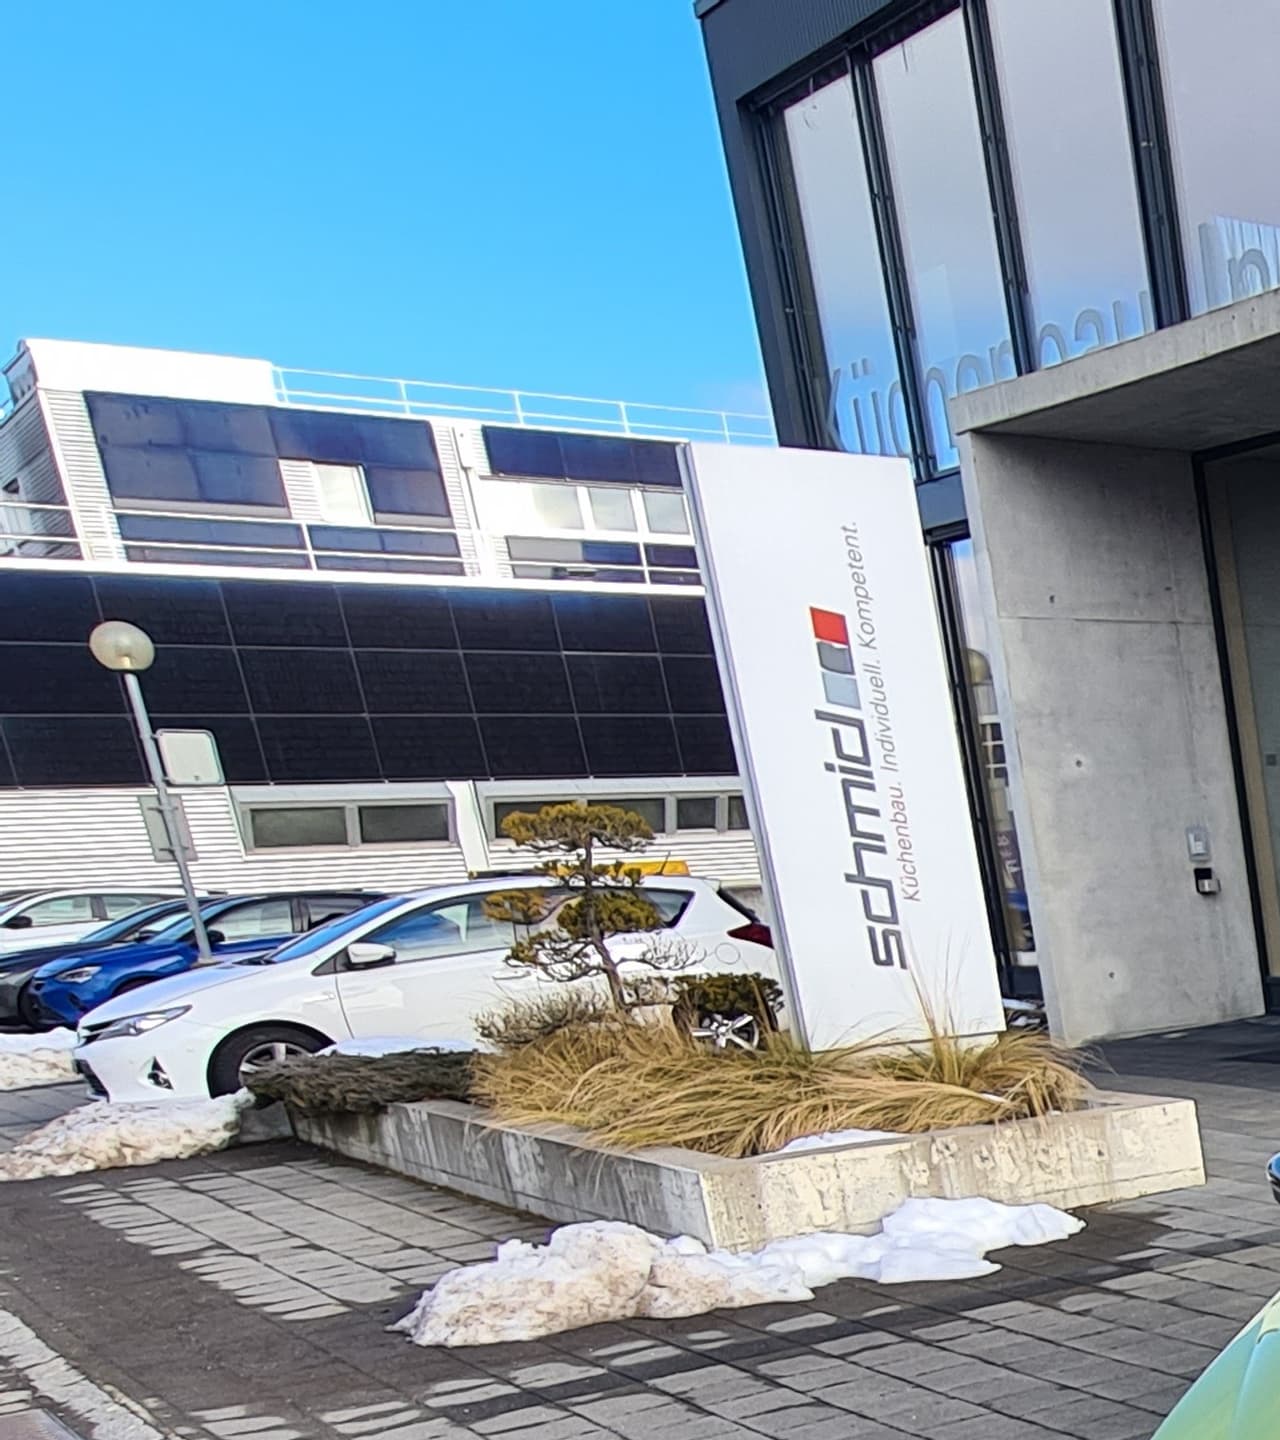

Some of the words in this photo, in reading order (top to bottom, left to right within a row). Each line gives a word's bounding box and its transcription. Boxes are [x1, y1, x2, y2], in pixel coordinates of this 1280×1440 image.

[840, 521, 877, 650] Kompetent.
[861, 659, 899, 773] Individuell.
[814, 708, 908, 970] schmid
[888, 781, 921, 902] Küchenbau.
